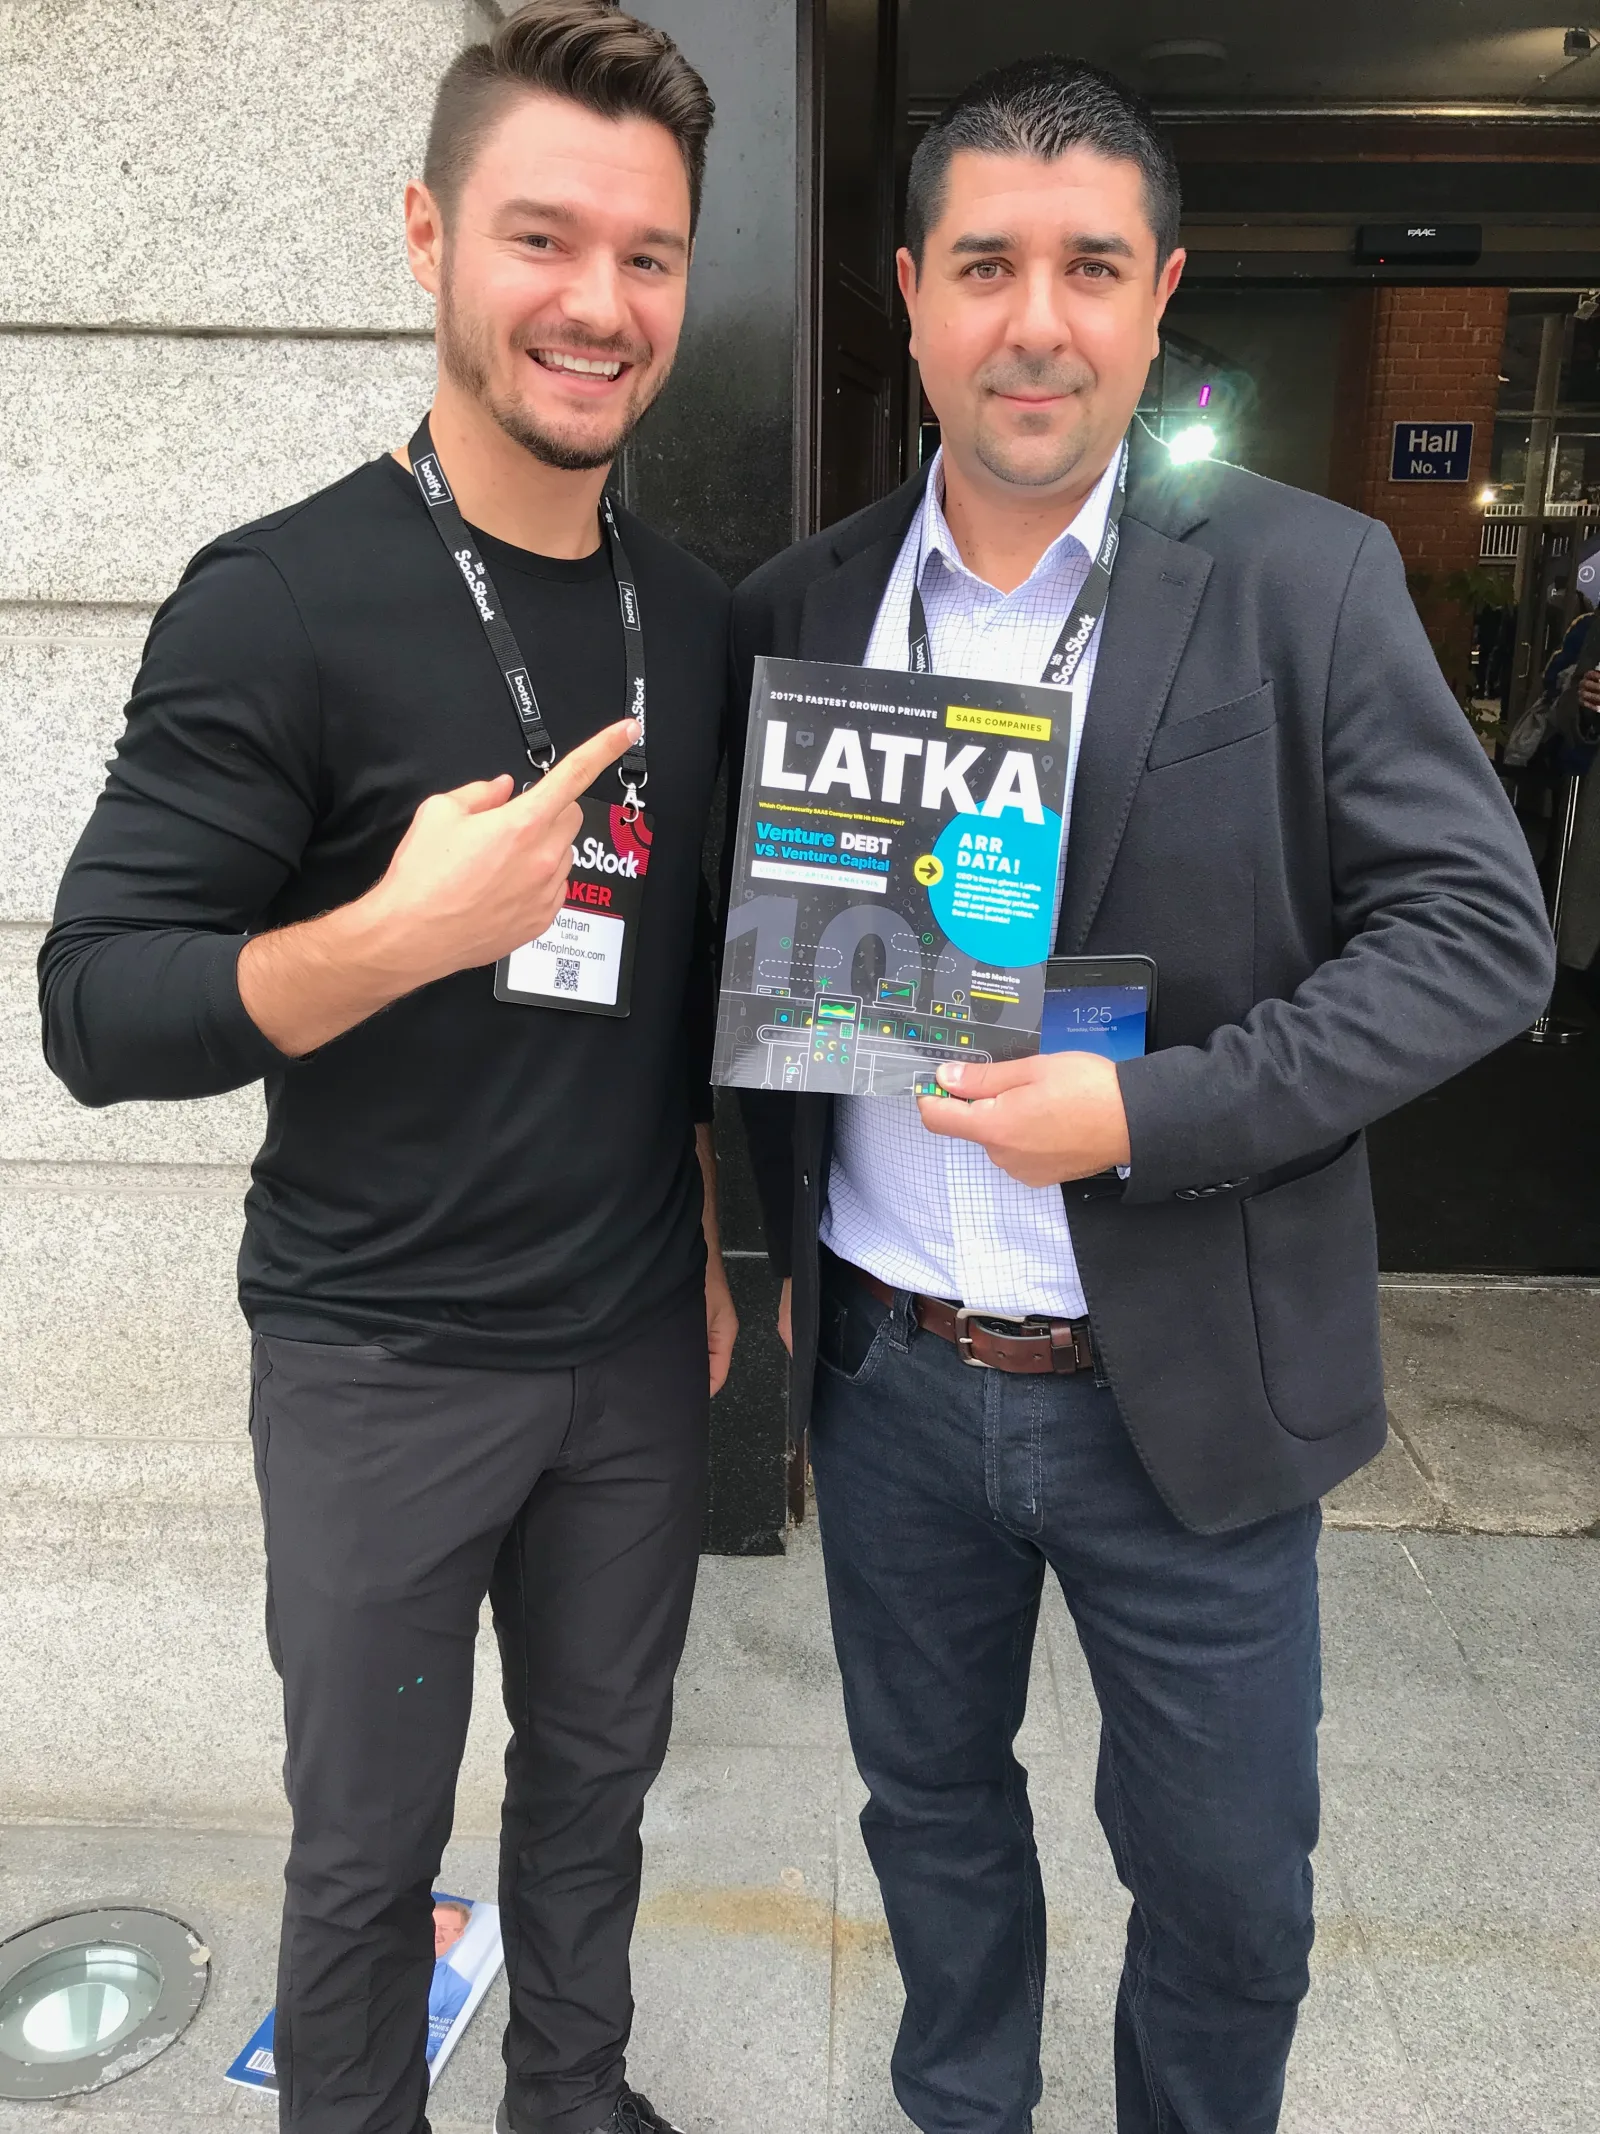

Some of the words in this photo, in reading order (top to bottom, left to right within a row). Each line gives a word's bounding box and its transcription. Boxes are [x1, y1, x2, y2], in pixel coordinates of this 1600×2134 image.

[1407, 228, 1436, 237] FAAC
[1408, 430, 1458, 453] Hall
[421, 460, 446, 499] botify
[1410, 460, 1437, 475] No.
[1444, 460, 1452, 474] 1
[454, 549, 495, 622] SaaStock
[622, 587, 635, 624] botify
[514, 675, 536, 716] botify
[770, 691, 803, 703] 2017'S
[805, 695, 847, 708] FASTEST
[849, 700, 896, 714] GROWING
[897, 706, 938, 720] PRIVATE
[956, 714, 981, 724] SAAS
[985, 717, 1042, 732] COMPANIES
[760, 720, 1046, 825] LATKA
[759, 801, 776, 810] Which
[776, 803, 813, 815] Cybersecurity
[756, 821, 835, 848] Venture
[840, 832, 892, 855] DEBT
[958, 832, 1003, 854] ARR
[754, 843, 779, 858] VS.
[781, 846, 838, 864] Venture
[840, 854, 890, 872] Capital
[956, 850, 1021, 875] DATA!
[553, 915, 590, 933] Nathan
[560, 931, 579, 942] Latka
[531, 938, 606, 962] TheTopInbox.com
[971, 970, 991, 979] SaaS
[991, 973, 1020, 984] Metrics
[1072, 1006, 1112, 1024] 1:25
